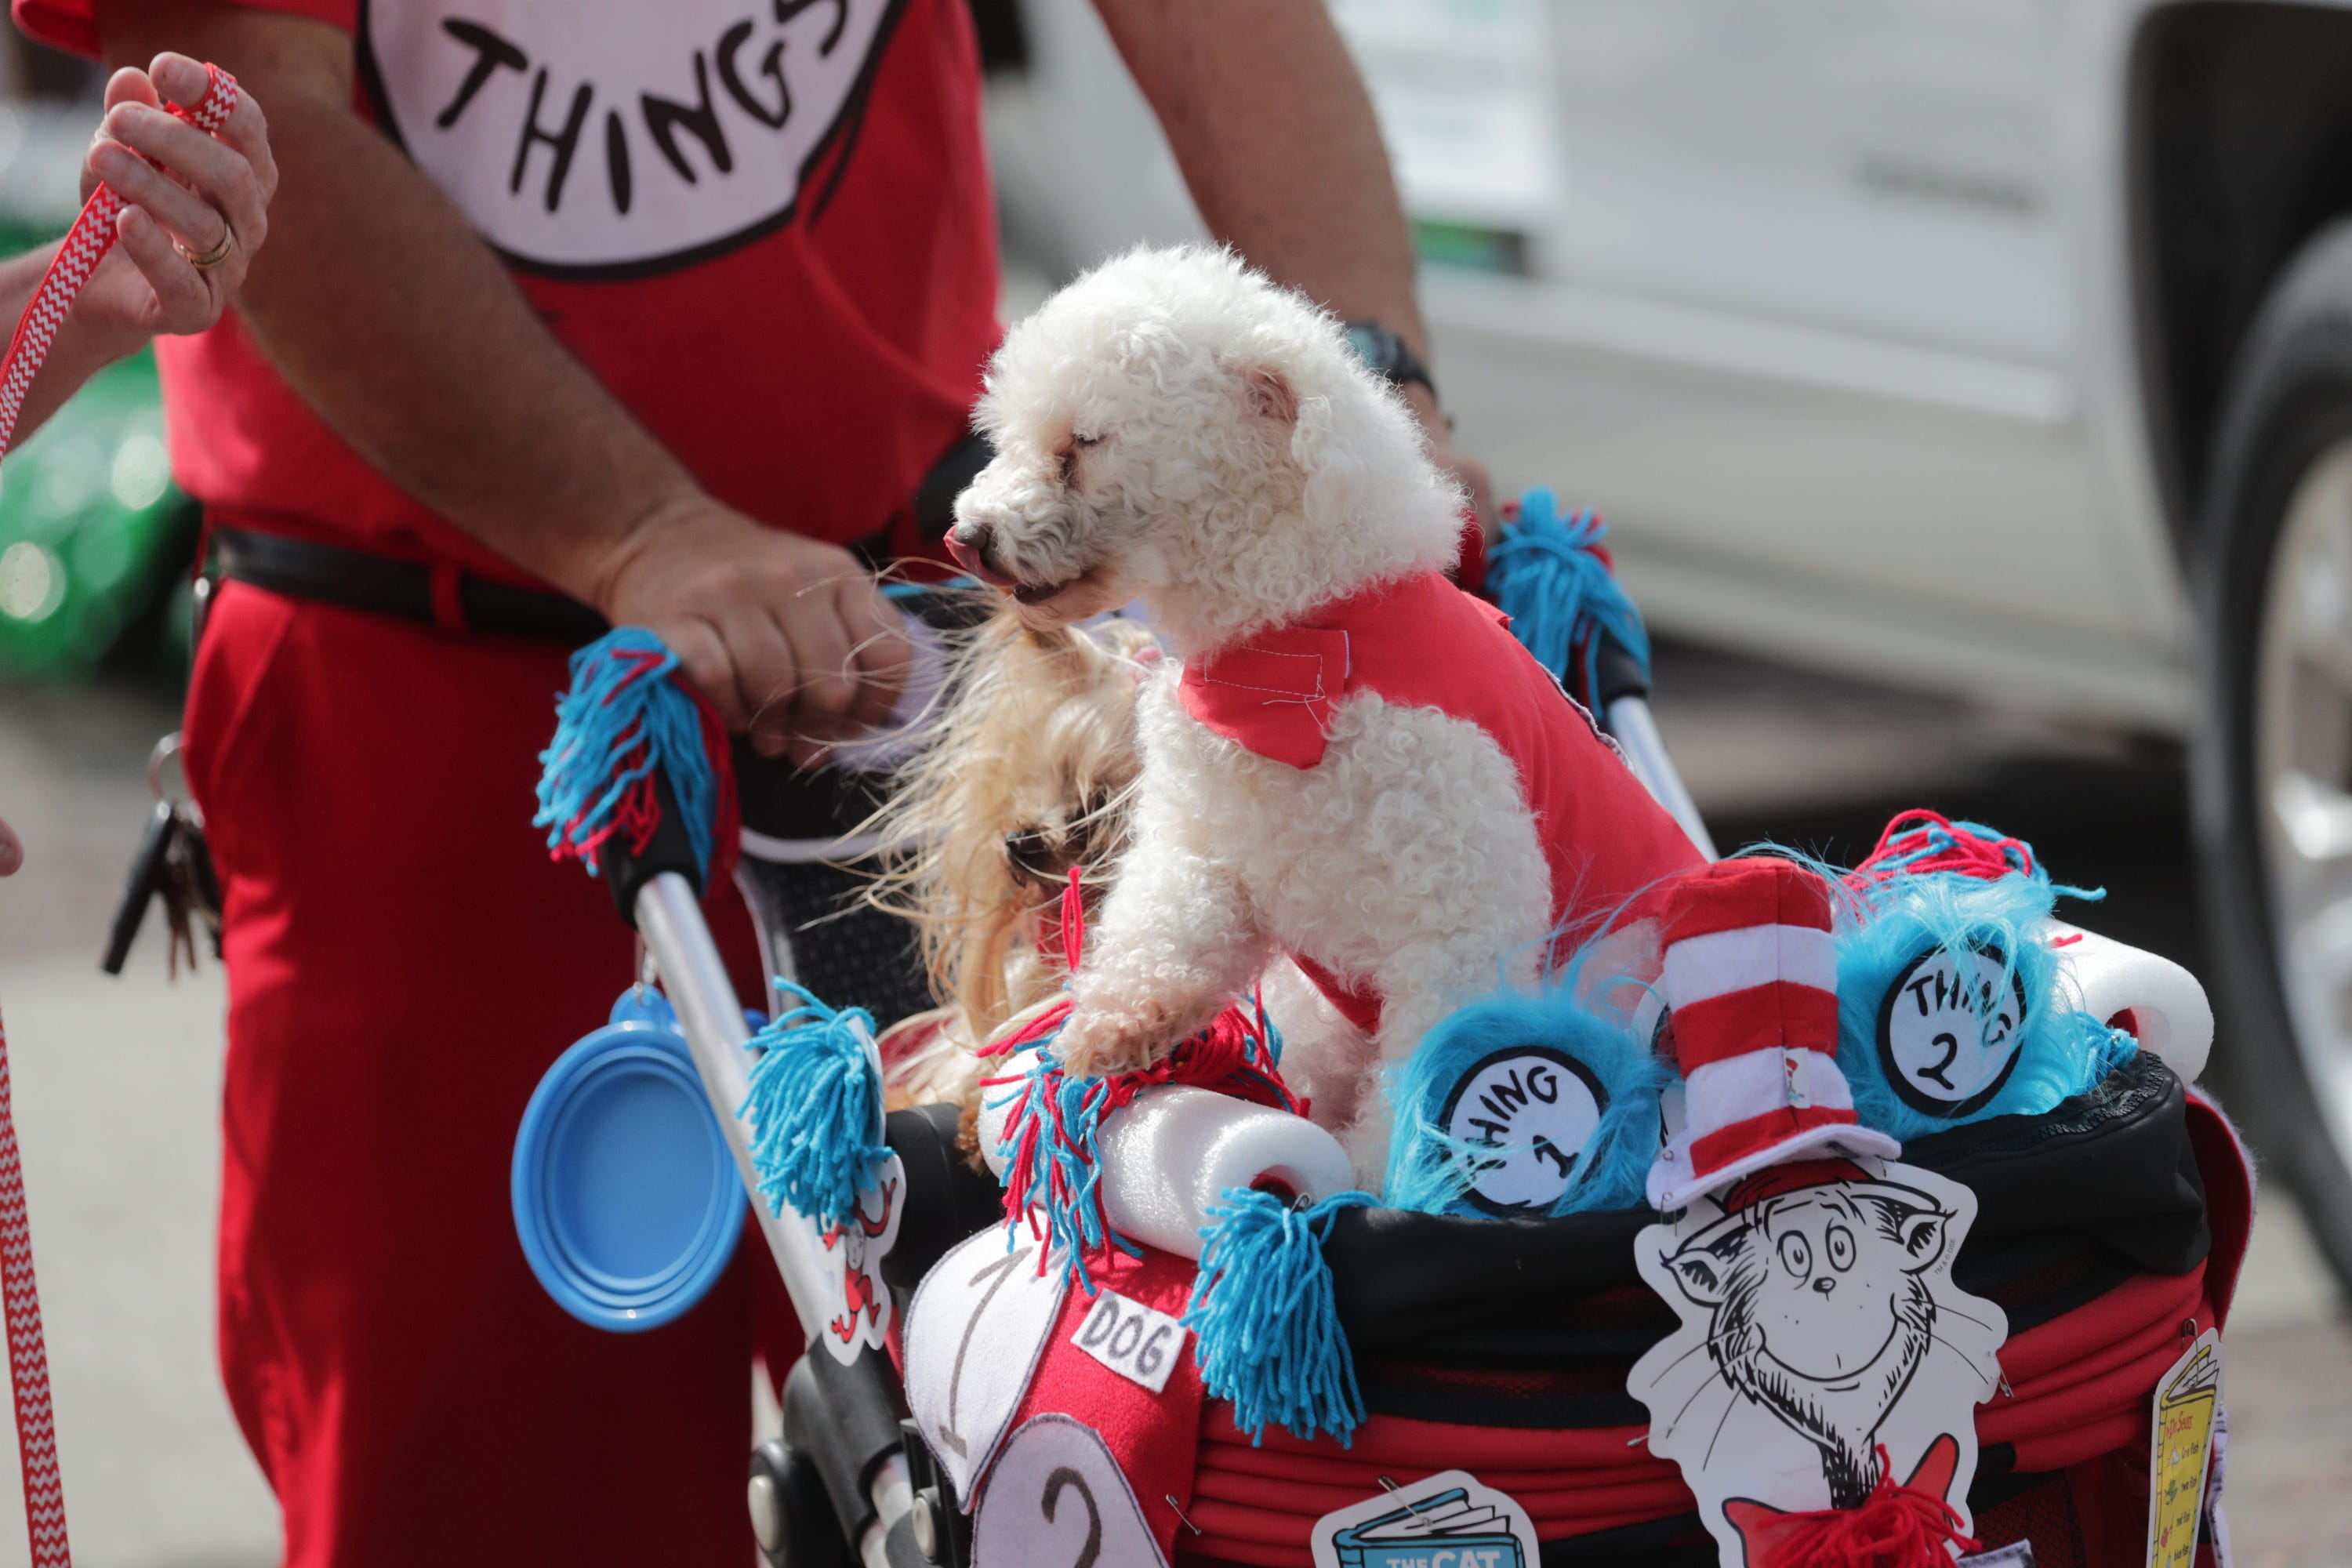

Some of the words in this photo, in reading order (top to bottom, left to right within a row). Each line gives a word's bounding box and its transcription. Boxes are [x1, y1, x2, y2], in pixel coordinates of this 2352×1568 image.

[434, 0, 848, 215] THINGS
[1905, 969, 2012, 1048] THING
[1917, 1032, 1958, 1091] 2
[1465, 1065, 1557, 1185] THING
[1533, 1134, 1580, 1178] 1
[938, 1247, 1033, 1459] 1
[1081, 1300, 1172, 1376] DOG
[1040, 1466, 1102, 1568] 2
[1386, 1558, 1428, 1568] THE
[1432, 1550, 1501, 1568] CAT
